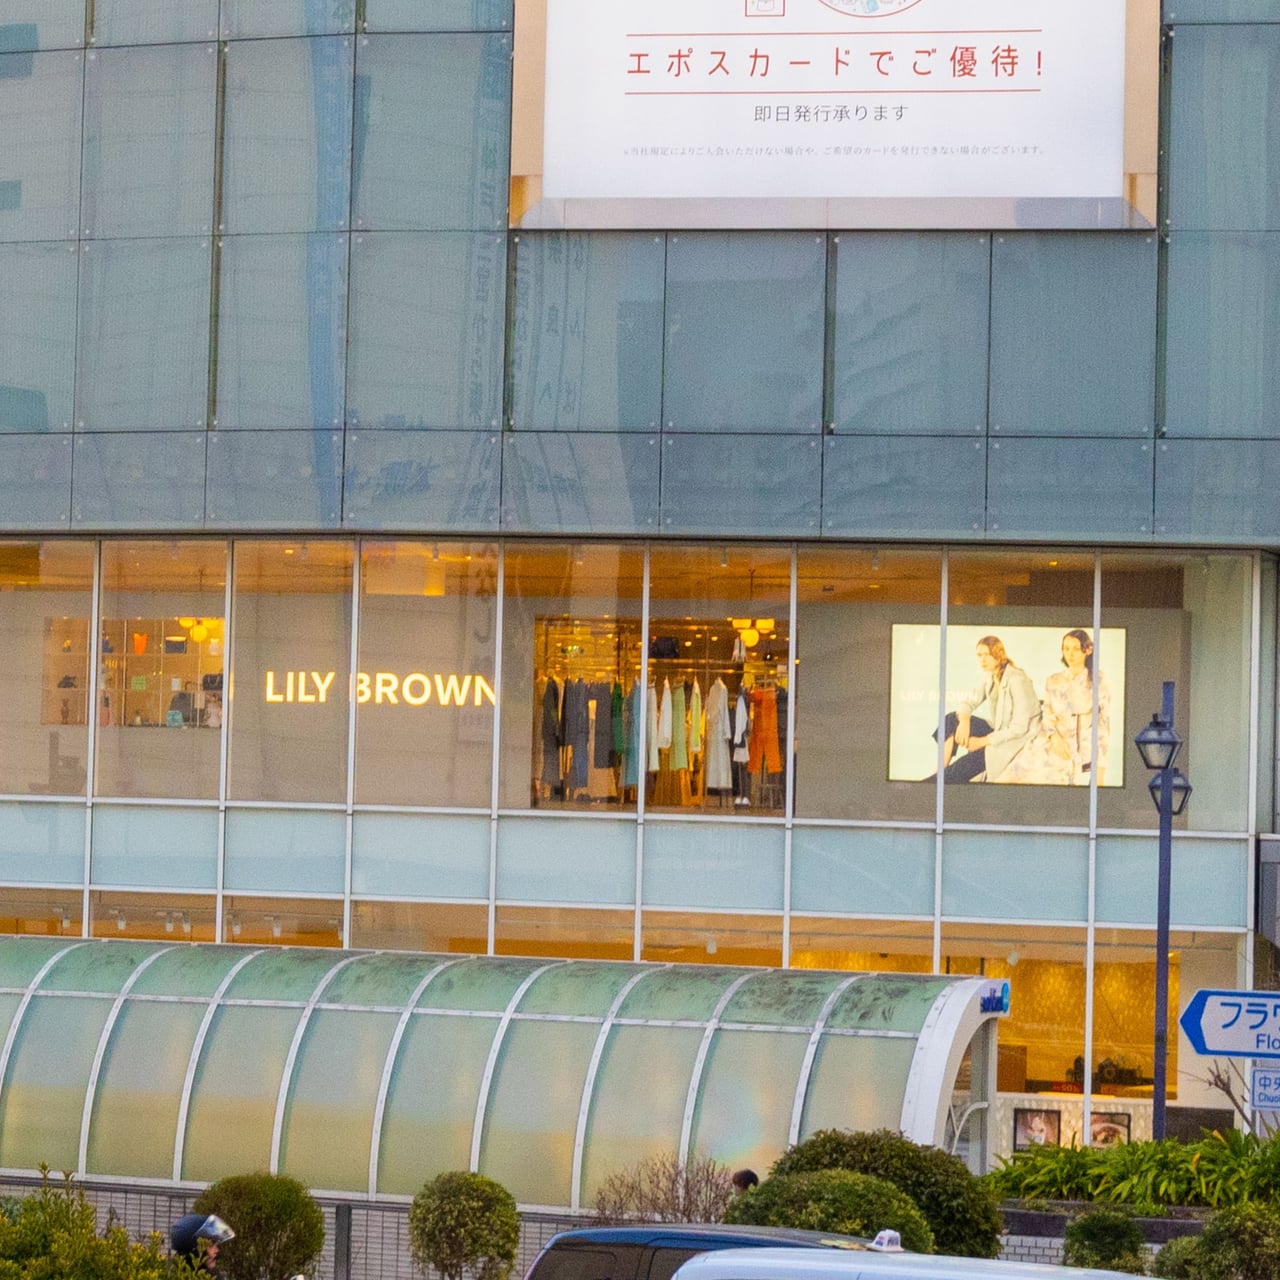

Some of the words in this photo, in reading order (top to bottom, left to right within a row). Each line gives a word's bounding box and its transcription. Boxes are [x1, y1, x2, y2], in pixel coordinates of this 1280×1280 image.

[754, 103, 910, 124] 即日発行承ります
[265, 671, 335, 703] LILY
[351, 672, 497, 707] BROWN
[1258, 1091, 1280, 1103] Chuo
